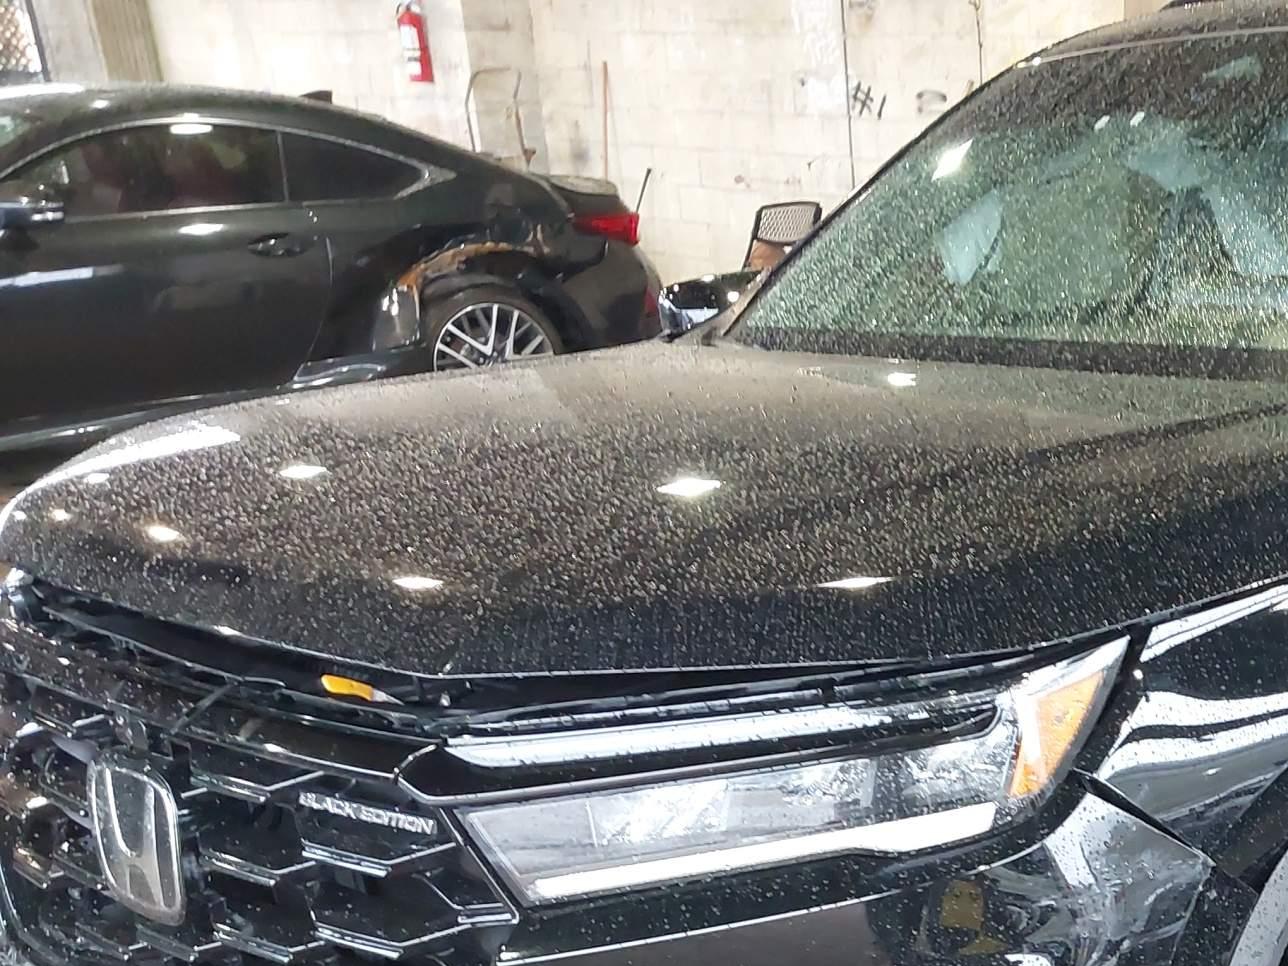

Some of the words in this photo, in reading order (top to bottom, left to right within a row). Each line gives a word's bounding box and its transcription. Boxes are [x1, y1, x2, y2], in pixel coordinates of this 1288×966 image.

[852, 80, 887, 120] #1
[298, 791, 357, 819] BLACK
[358, 806, 437, 835] EDITION
